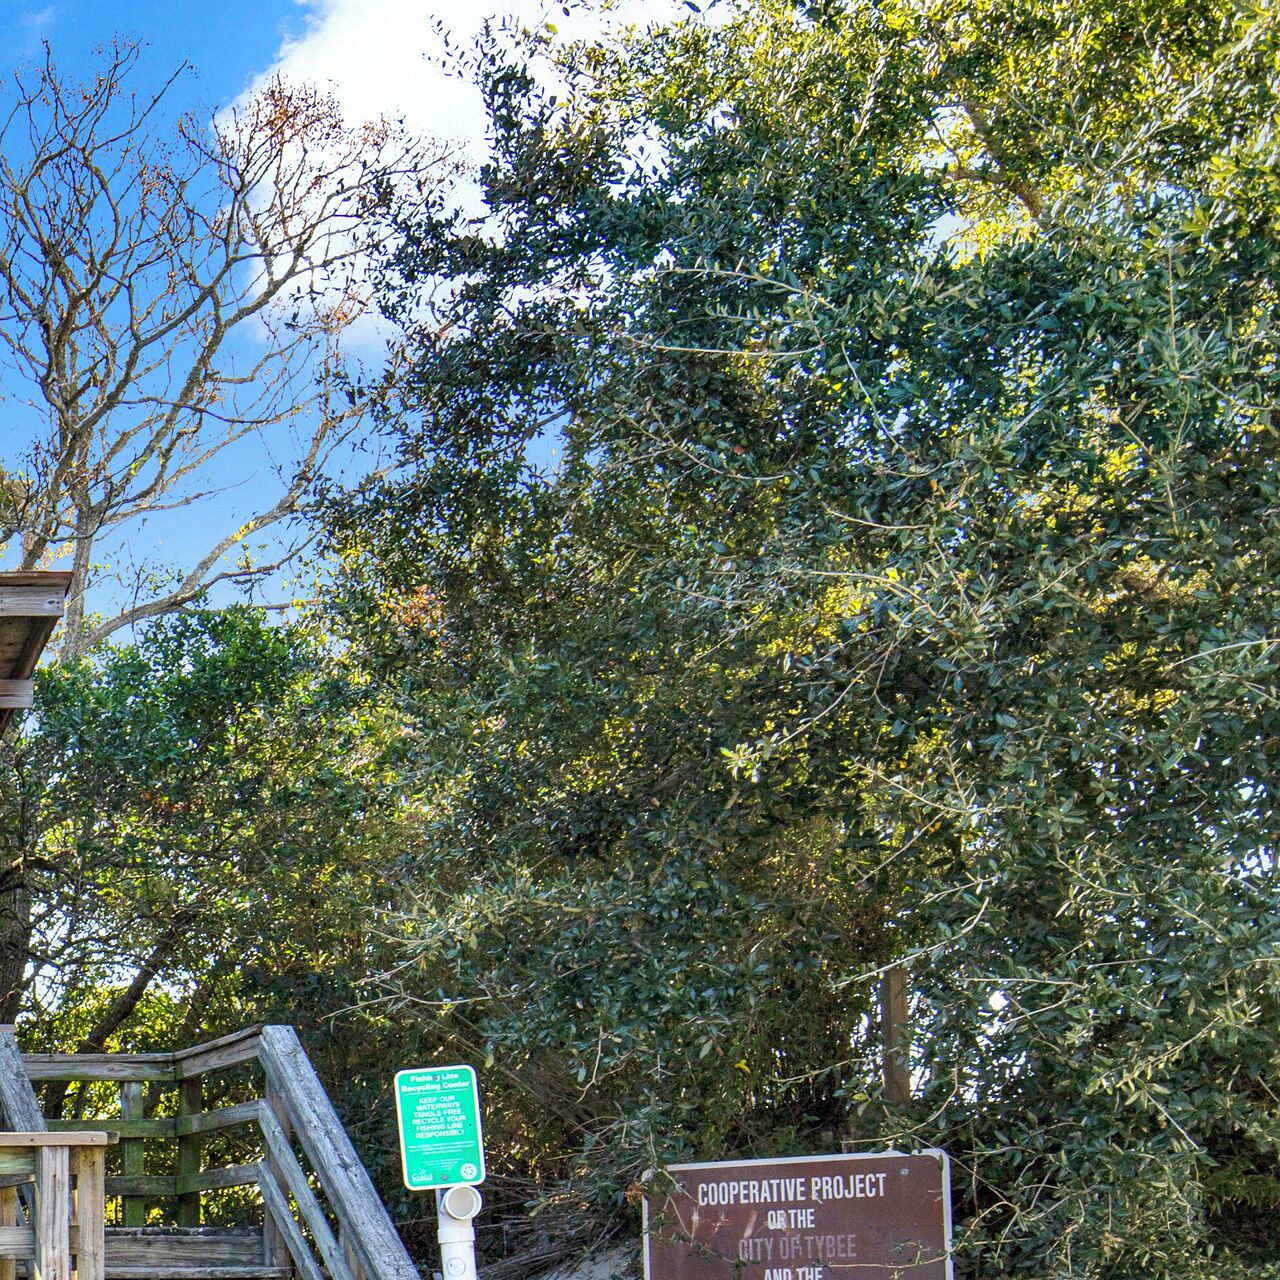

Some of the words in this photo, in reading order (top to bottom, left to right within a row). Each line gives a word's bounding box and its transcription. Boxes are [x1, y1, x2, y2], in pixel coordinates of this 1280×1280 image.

[401, 1083, 441, 1092] Recycling
[416, 1102, 460, 1111] WATERWAYS
[698, 1178, 806, 1207] COOPERATIVE
[811, 1173, 887, 1201] PROJECT
[767, 1210, 785, 1230] OF
[788, 1209, 815, 1228] THE
[738, 1237, 772, 1261] CITY
[779, 1235, 801, 1259] OF
[805, 1233, 857, 1259] TYBEE
